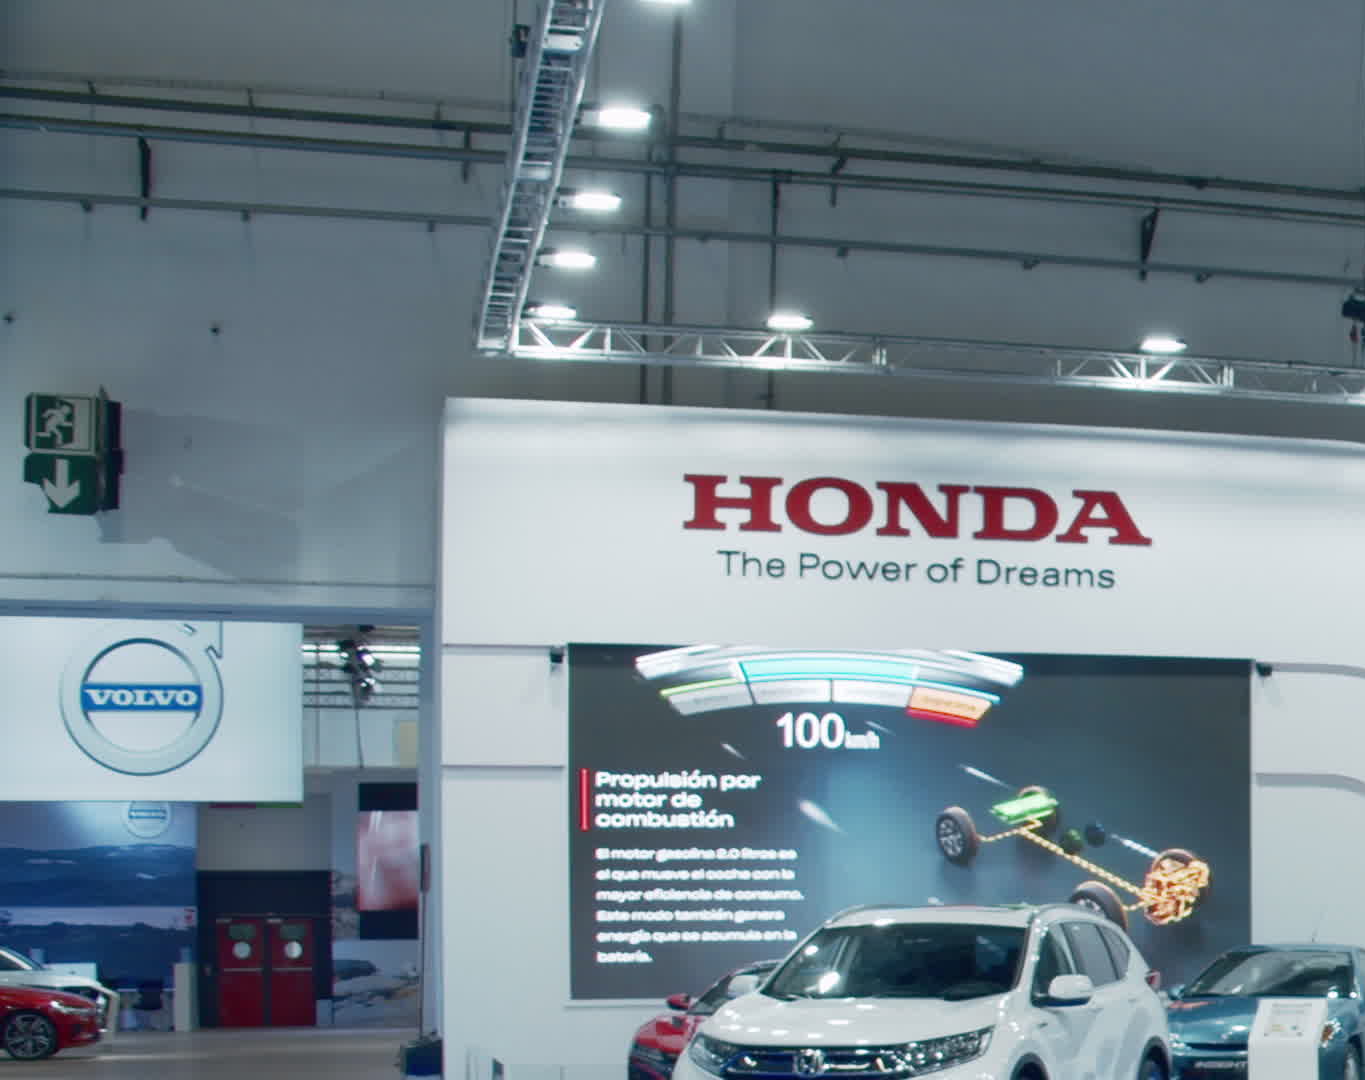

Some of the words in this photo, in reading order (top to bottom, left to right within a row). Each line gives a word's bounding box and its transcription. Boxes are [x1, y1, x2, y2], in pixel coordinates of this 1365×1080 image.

[683, 473, 1153, 547] HONDA
[717, 549, 785, 578] The
[799, 552, 917, 583] Power
[927, 557, 965, 583] of
[977, 559, 1116, 589] Dreams
[85, 688, 198, 706] VOLVO
[776, 711, 846, 749] 100
[594, 769, 717, 791] Propulsión
[720, 774, 762, 792] por
[594, 792, 668, 808] motor
[670, 791, 703, 809] de
[594, 809, 735, 828] combustión
